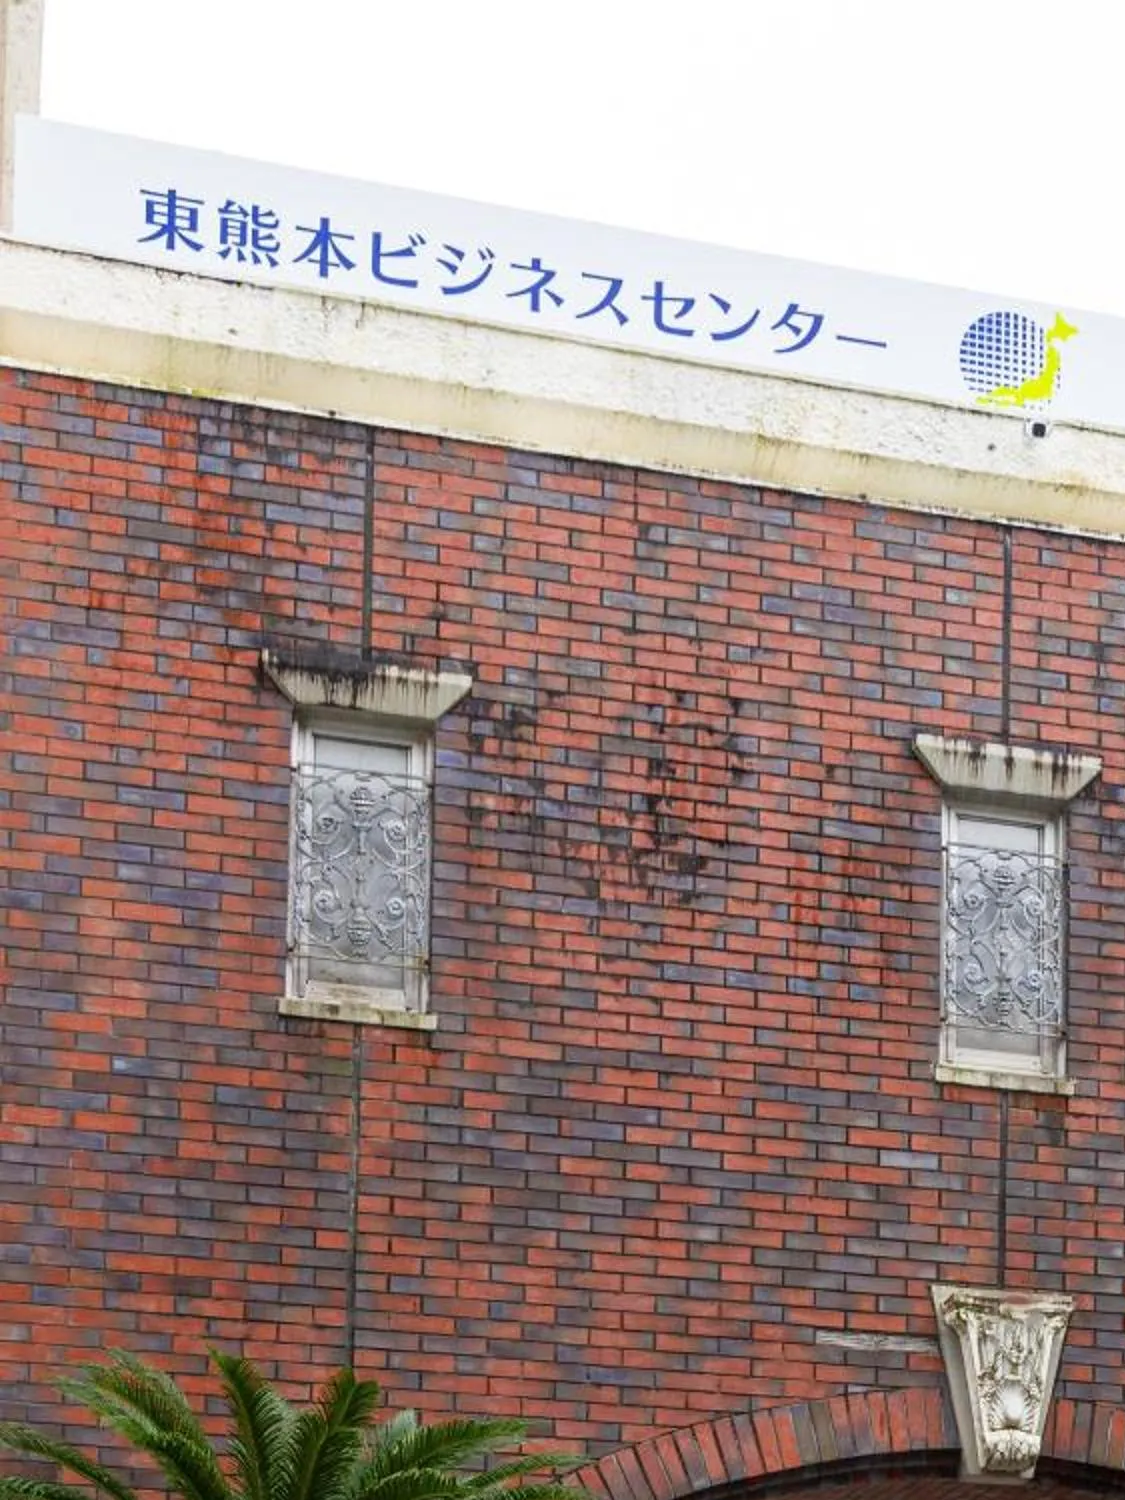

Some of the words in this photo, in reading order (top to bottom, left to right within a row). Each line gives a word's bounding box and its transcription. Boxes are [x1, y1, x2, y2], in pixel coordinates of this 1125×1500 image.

[137, 188, 888, 354] 東熊本ビジネスセンター
